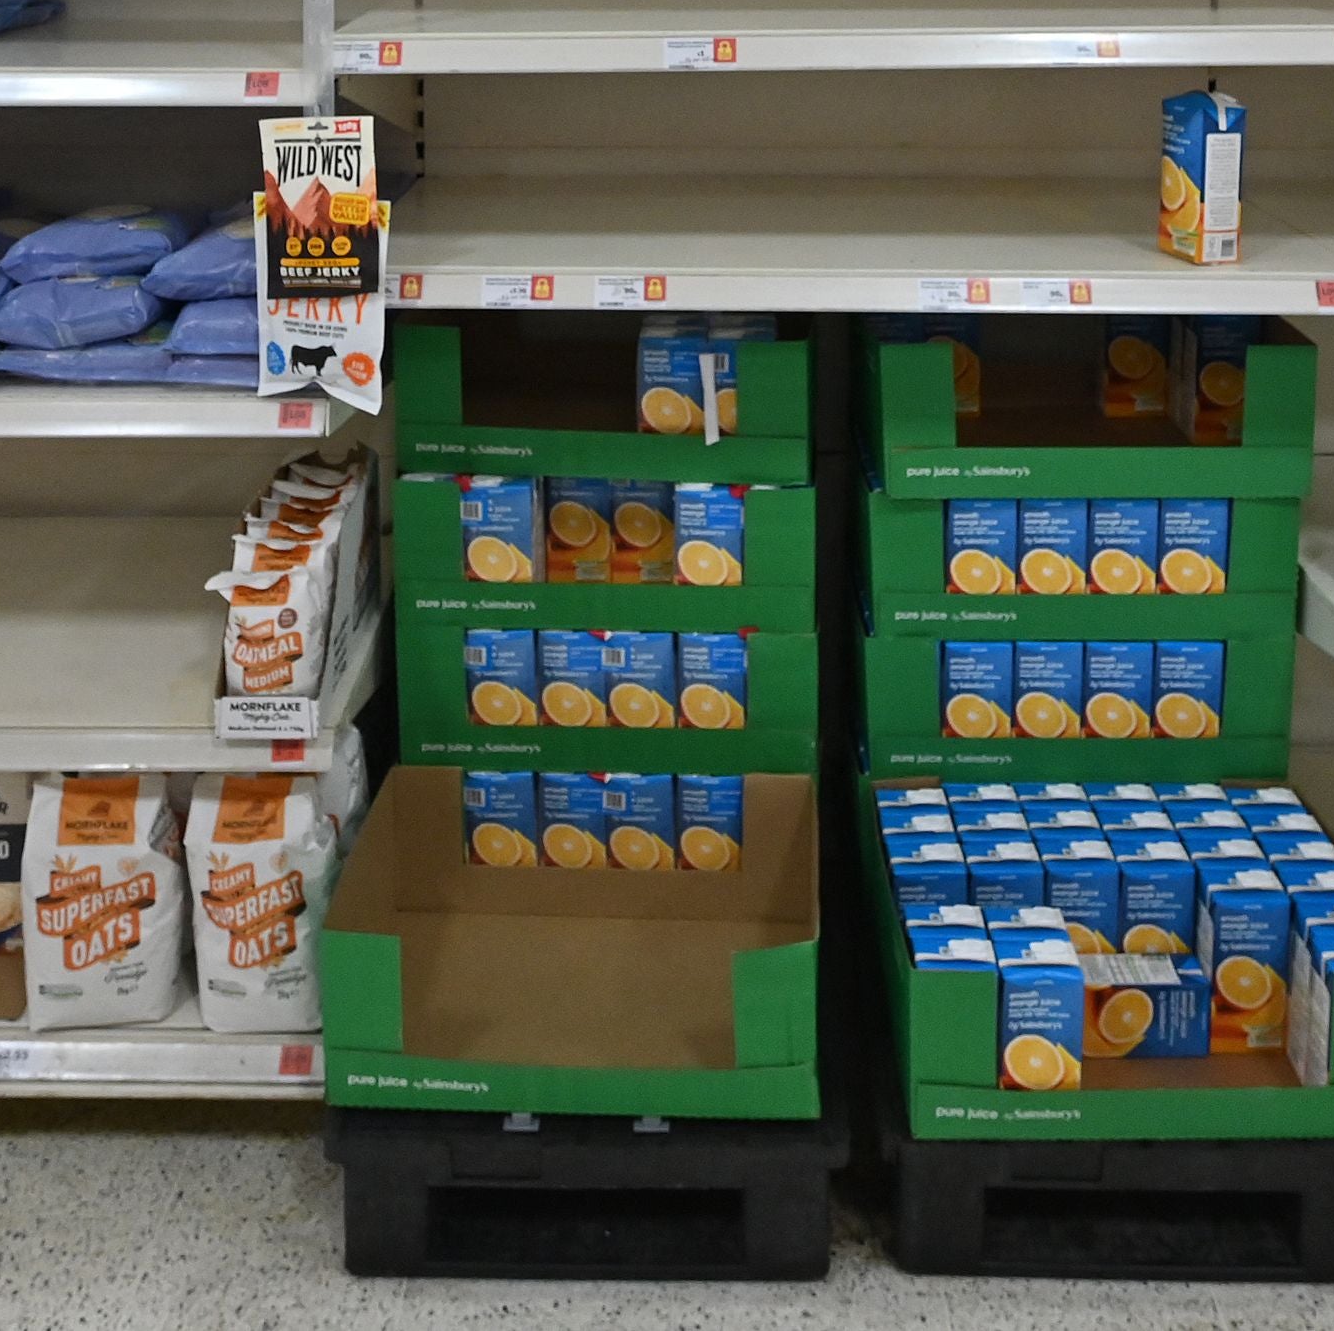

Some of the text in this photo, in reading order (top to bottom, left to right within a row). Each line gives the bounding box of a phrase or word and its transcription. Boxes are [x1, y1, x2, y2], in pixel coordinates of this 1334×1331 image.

[275, 145, 363, 187] WILD WEST
[280, 266, 361, 277] BEEF JERKY
[906, 466, 932, 478] pure
[415, 599, 440, 609] pure
[235, 634, 299, 664] OATMEAL
[229, 701, 301, 713] MORNFLAKE
[40, 875, 152, 932] SUPERFAST
[70, 912, 135, 968] OATS
[233, 920, 289, 966] OATS
[347, 1074, 376, 1086] pure
